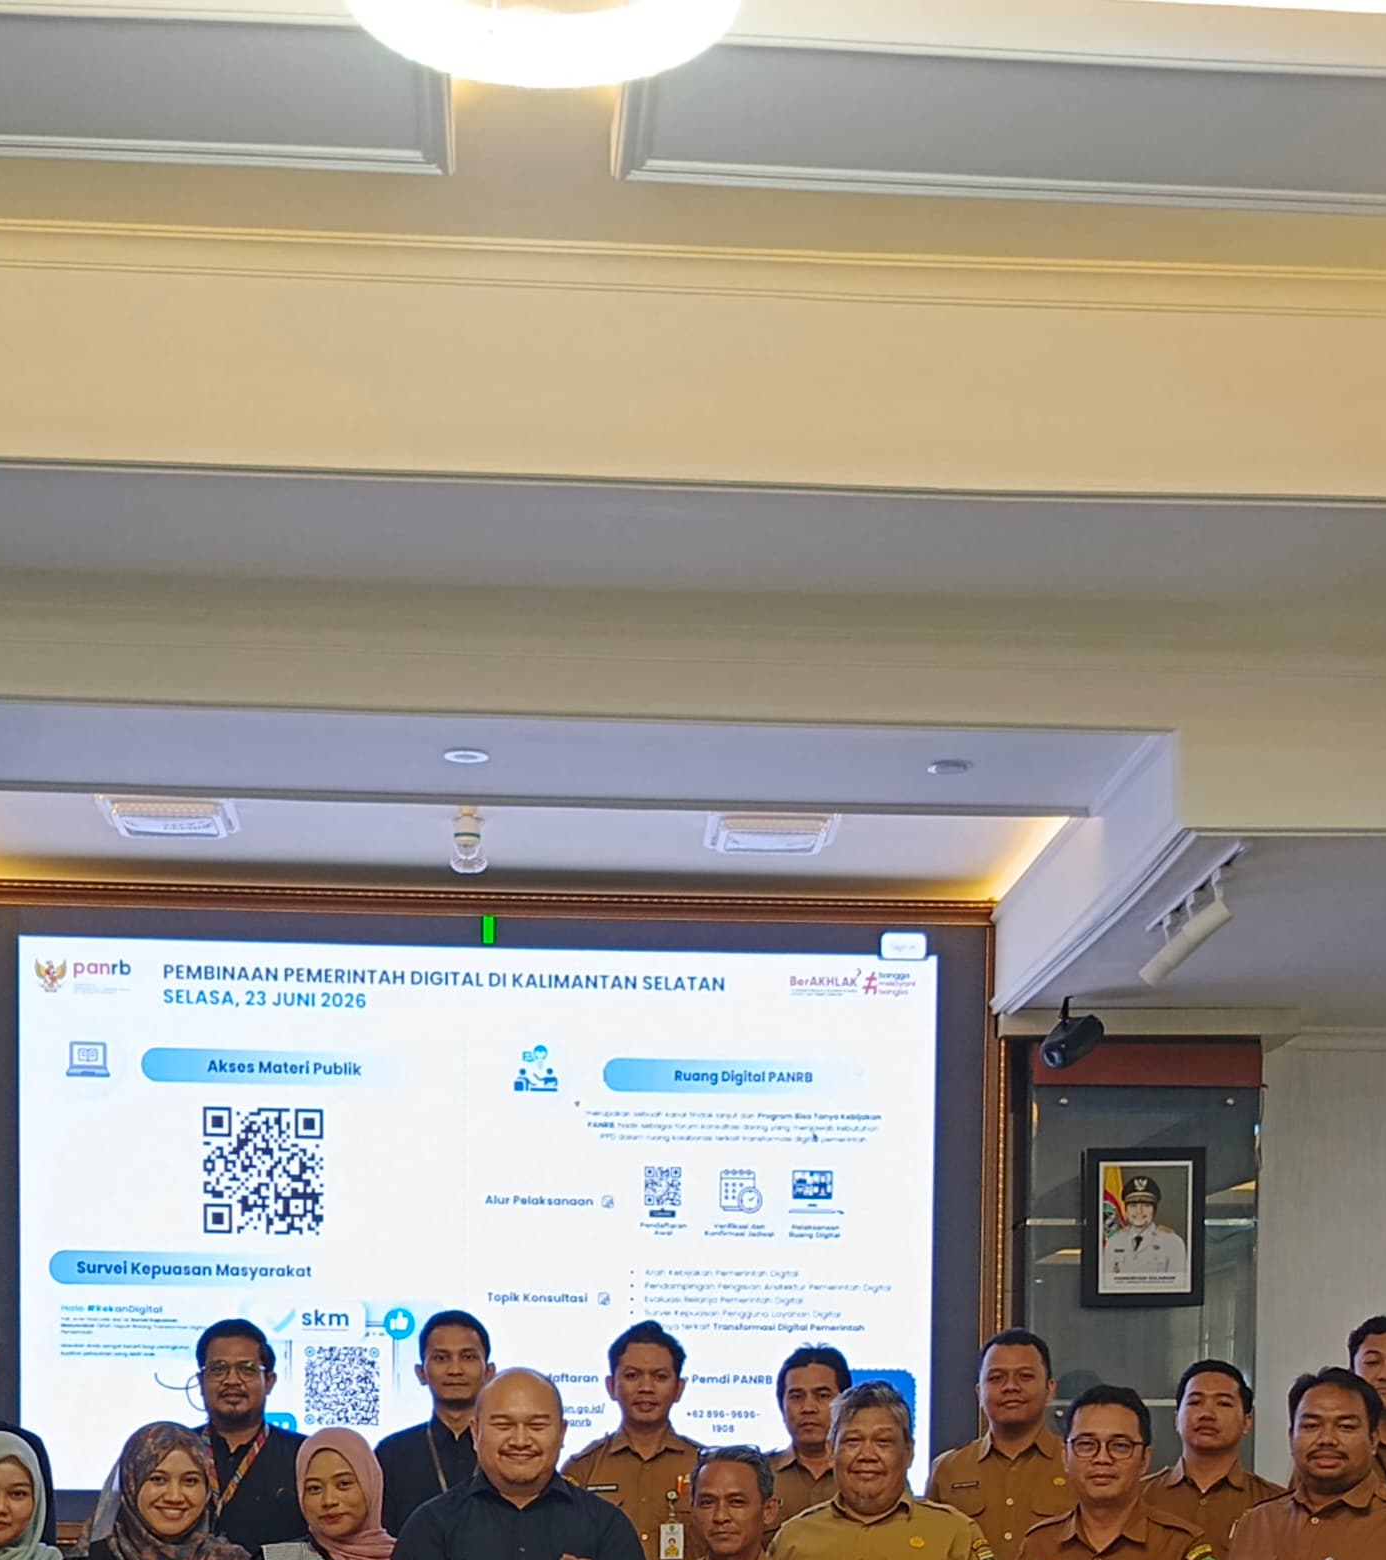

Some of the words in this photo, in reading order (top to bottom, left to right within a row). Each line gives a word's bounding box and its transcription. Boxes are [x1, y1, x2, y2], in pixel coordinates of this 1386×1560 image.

[74, 959, 131, 978] panrb
[164, 964, 278, 982] PEMBINAAN
[284, 968, 405, 984] PEMERINTAH
[411, 971, 484, 987] DIGITAL
[489, 972, 506, 987] DI
[512, 973, 637, 990] KALIMANTAN
[643, 976, 725, 991] SELATAN
[790, 974, 859, 987] BerAKHLAK
[163, 989, 239, 1007] SELASA,
[245, 990, 266, 1006] 23
[272, 992, 315, 1007] JUNI
[321, 992, 366, 1008] 2026
[207, 1059, 254, 1073] Akses
[258, 1061, 309, 1074] Materi
[313, 1062, 361, 1075] Publik
[674, 1070, 718, 1086] Ruang
[721, 1070, 765, 1086] Digital
[768, 1071, 813, 1084] PANRB
[485, 1195, 510, 1205] Alur
[513, 1195, 594, 1206] Pelaksanaan
[77, 1260, 127, 1274] Survei
[130, 1262, 212, 1280] Kepuasan
[215, 1264, 311, 1281] Masyarakat
[770, 1270, 799, 1279] Digital
[863, 1284, 892, 1293] Digital
[488, 1292, 520, 1305] Topik
[523, 1293, 588, 1303] Konsultasi
[775, 1297, 804, 1306] Digital
[302, 1310, 349, 1326] skm
[813, 1311, 842, 1320] Digital
[713, 1323, 776, 1331] Transformasi
[777, 1324, 808, 1333] Digital
[810, 1324, 865, 1332] Pemerintah
[549, 1374, 598, 1384] aftaran
[692, 1374, 730, 1384] Pemdi
[733, 1375, 773, 1385] PANRB
[712, 1424, 734, 1433] 1908
